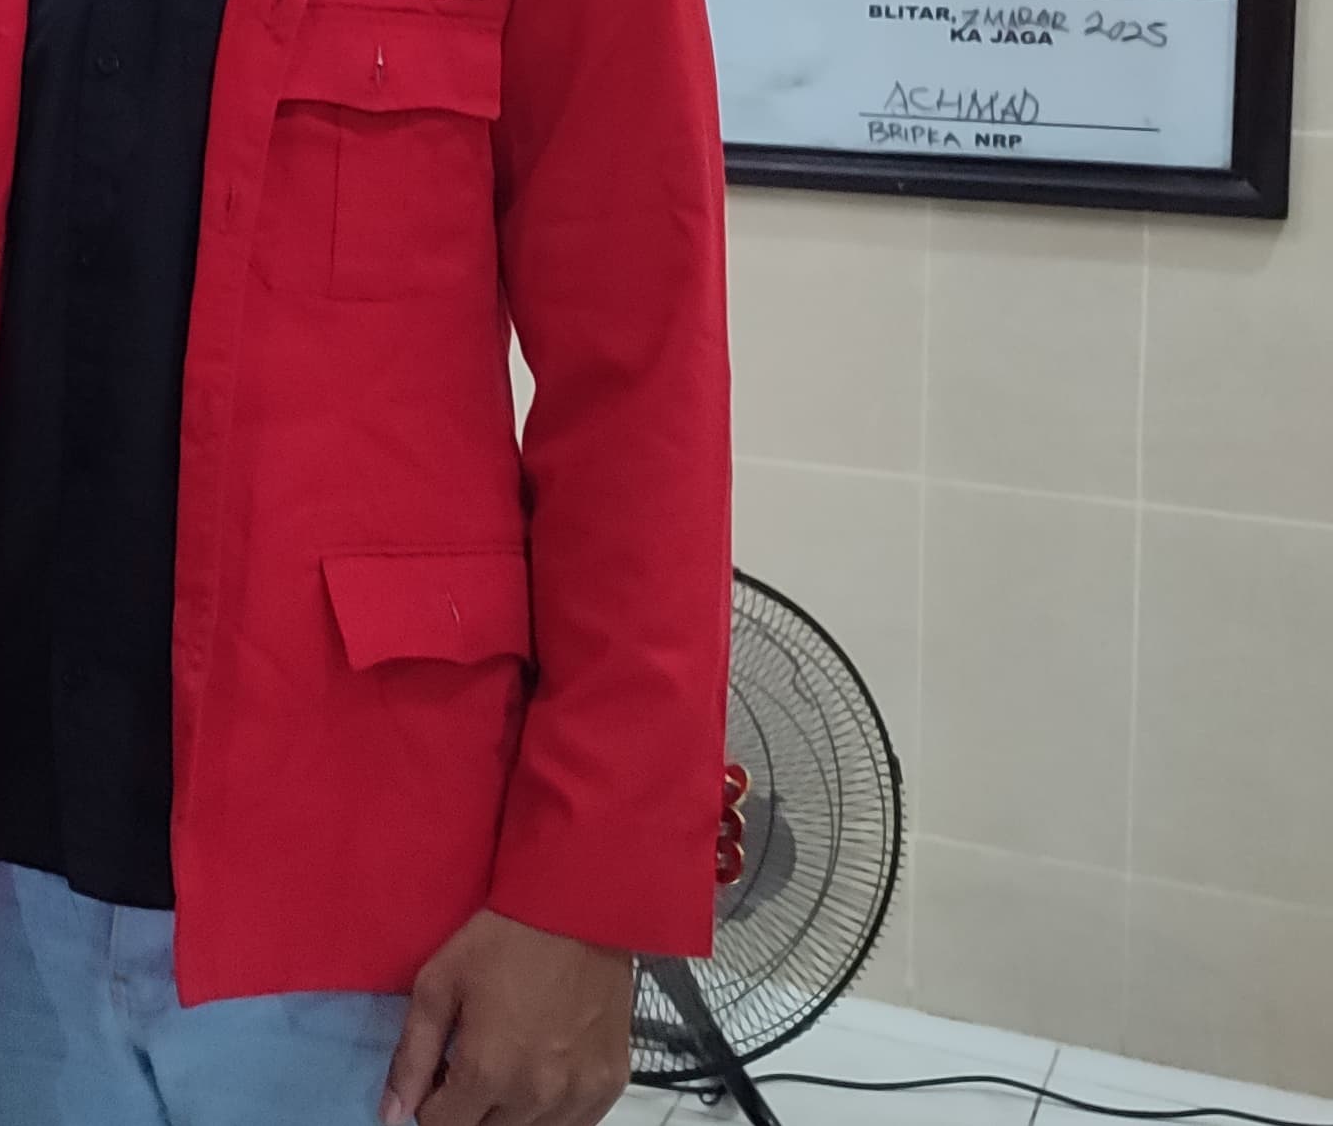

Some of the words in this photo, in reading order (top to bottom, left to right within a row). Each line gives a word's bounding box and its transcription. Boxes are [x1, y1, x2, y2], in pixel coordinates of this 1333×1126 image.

[868, 5, 958, 25] BLITAR,
[1084, 10, 1169, 48] 2025
[950, 27, 983, 45] KA
[990, 28, 1054, 46] JAGA
[974, 133, 1024, 149] NRP
